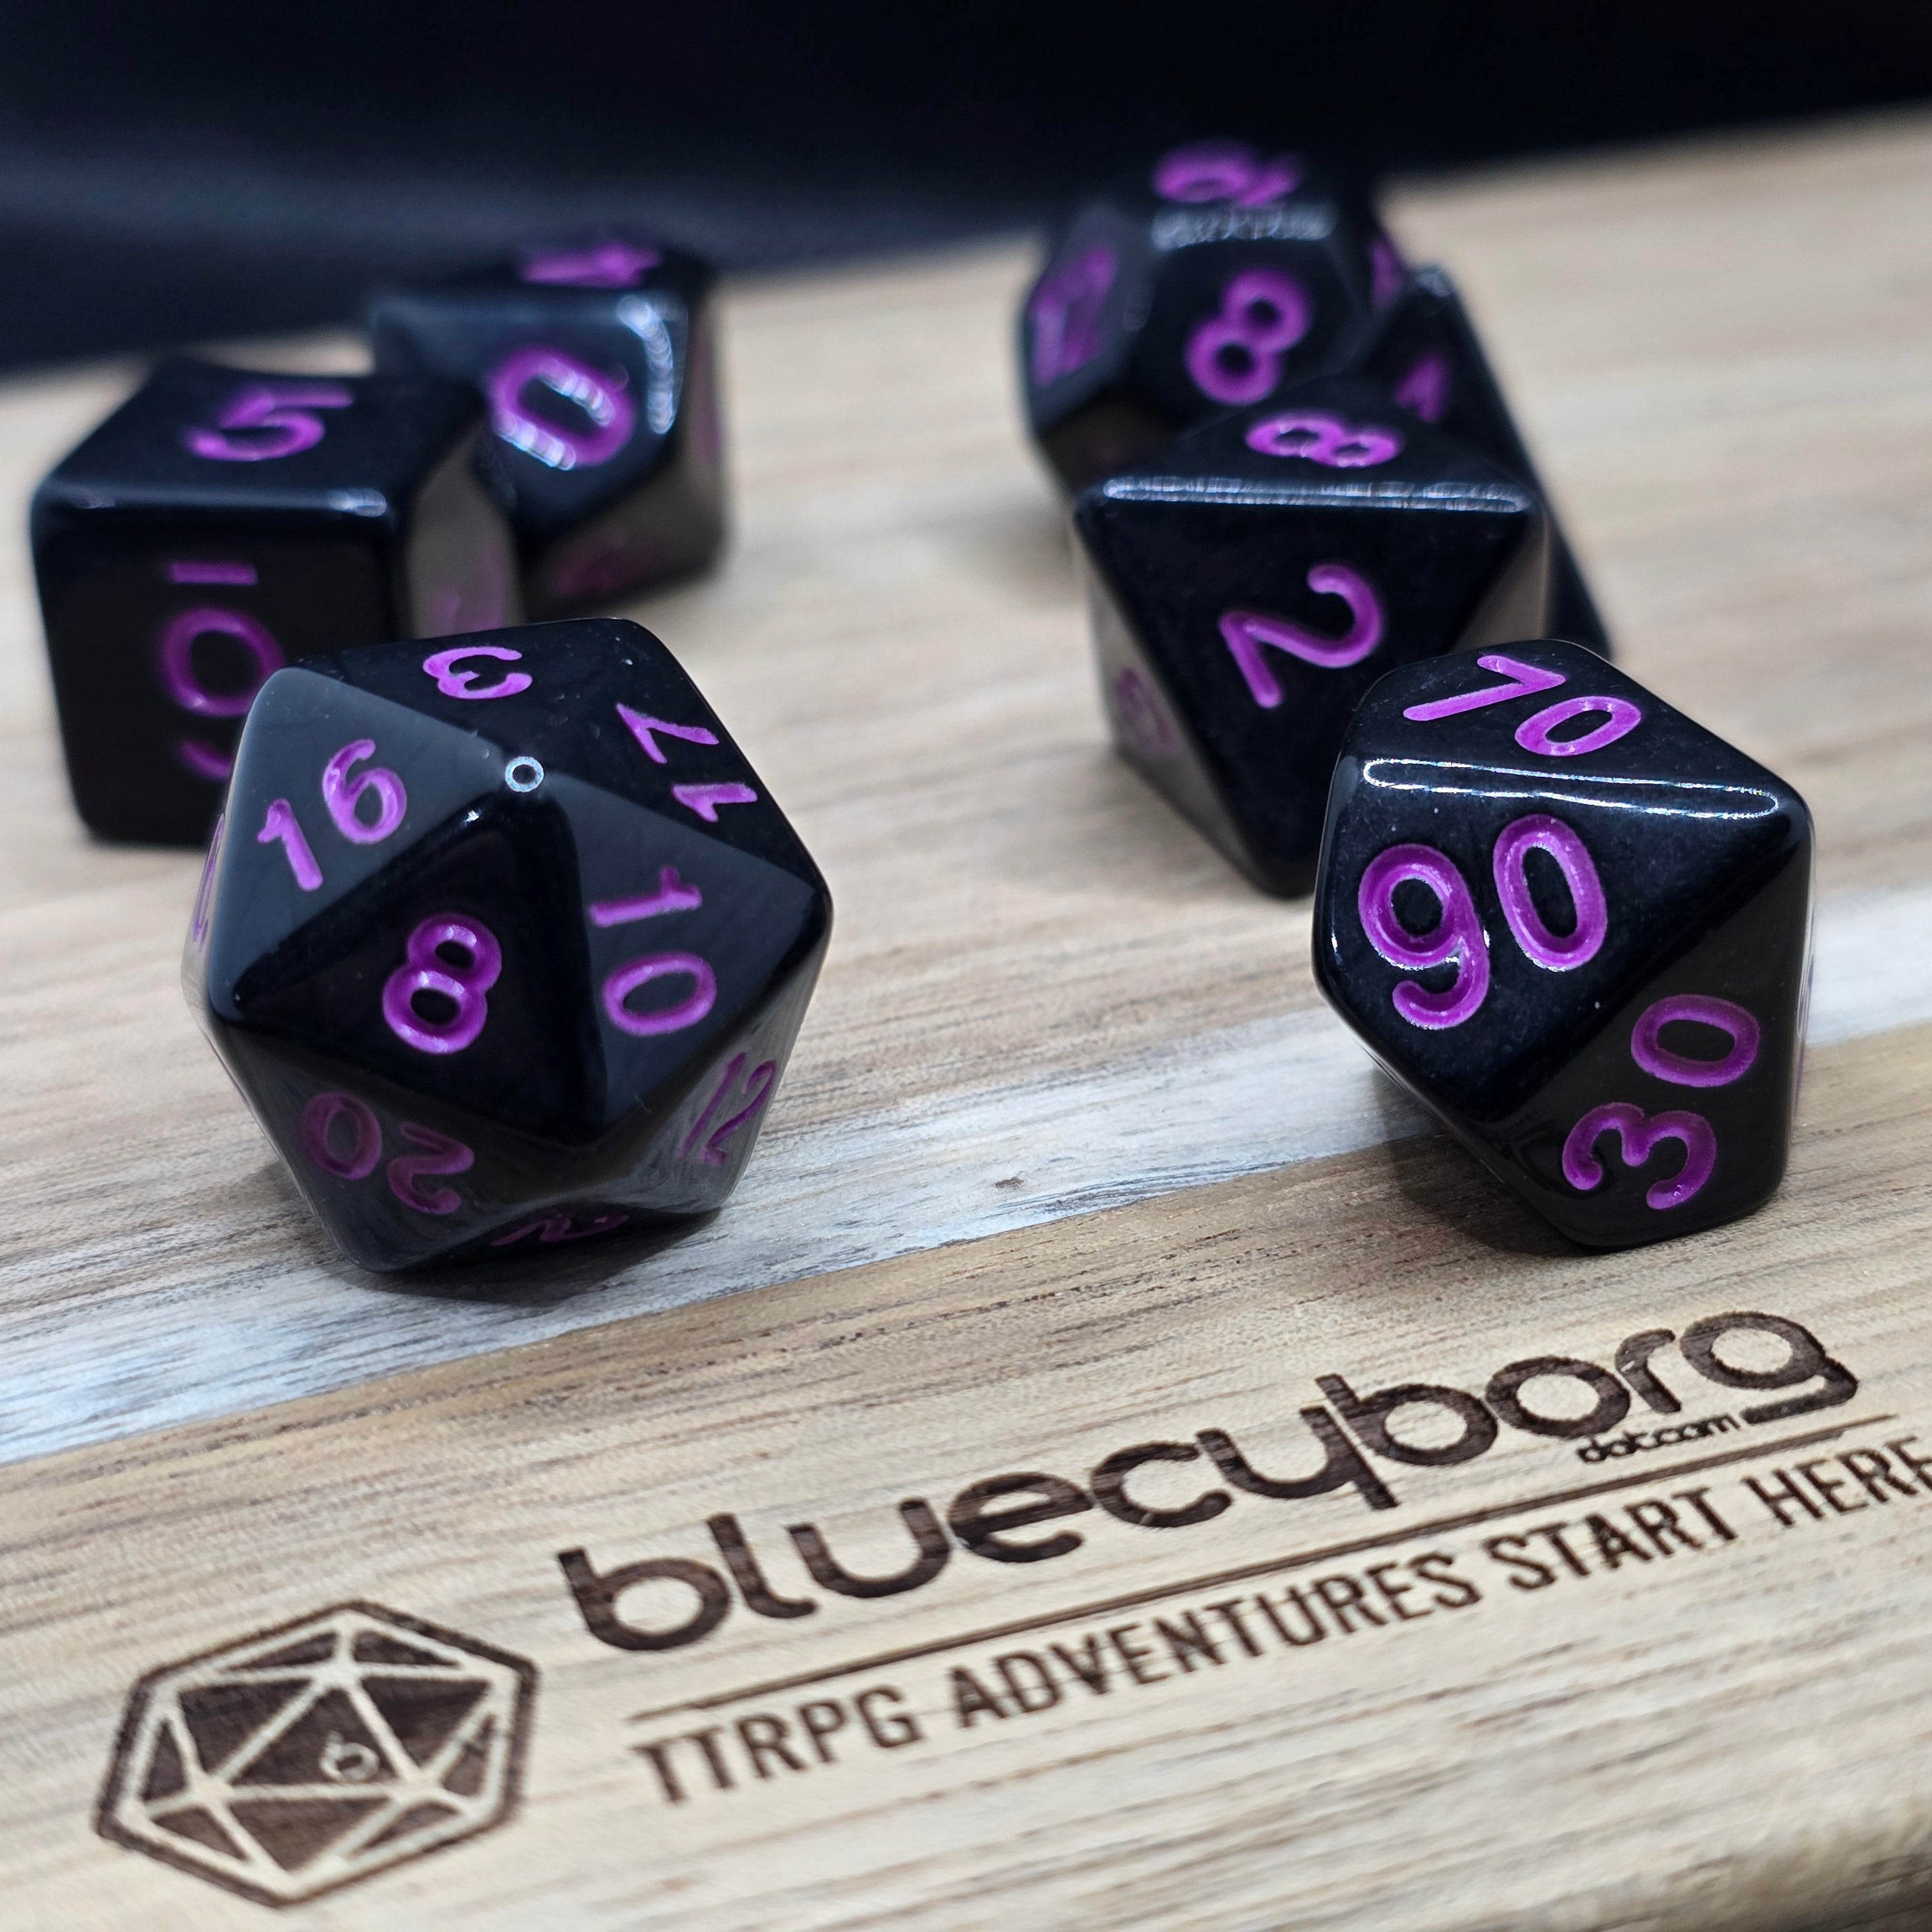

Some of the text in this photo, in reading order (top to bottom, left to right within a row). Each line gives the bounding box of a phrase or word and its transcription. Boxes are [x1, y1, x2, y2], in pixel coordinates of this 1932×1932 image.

[1183, 265, 1314, 404] 8
[184, 386, 352, 460] 5
[486, 345, 635, 468] 0
[1245, 411, 1403, 469] 8
[422, 646, 533, 701] 3
[1217, 563, 1384, 709] 2
[257, 738, 407, 891] 16
[615, 703, 758, 823] 17
[381, 912, 502, 1056] 8
[590, 866, 718, 1036] 10
[1357, 814, 1608, 1030] 90
[300, 1091, 474, 1215] 20
[679, 1051, 776, 1166] 12
[1561, 994, 1760, 1210] 30
[557, 1311, 1860, 1652] bluecyborg
[630, 1684, 925, 1805] TTRPG
[947, 1551, 1484, 1729] ADVENTURES
[1483, 1486, 1738, 1592] START
